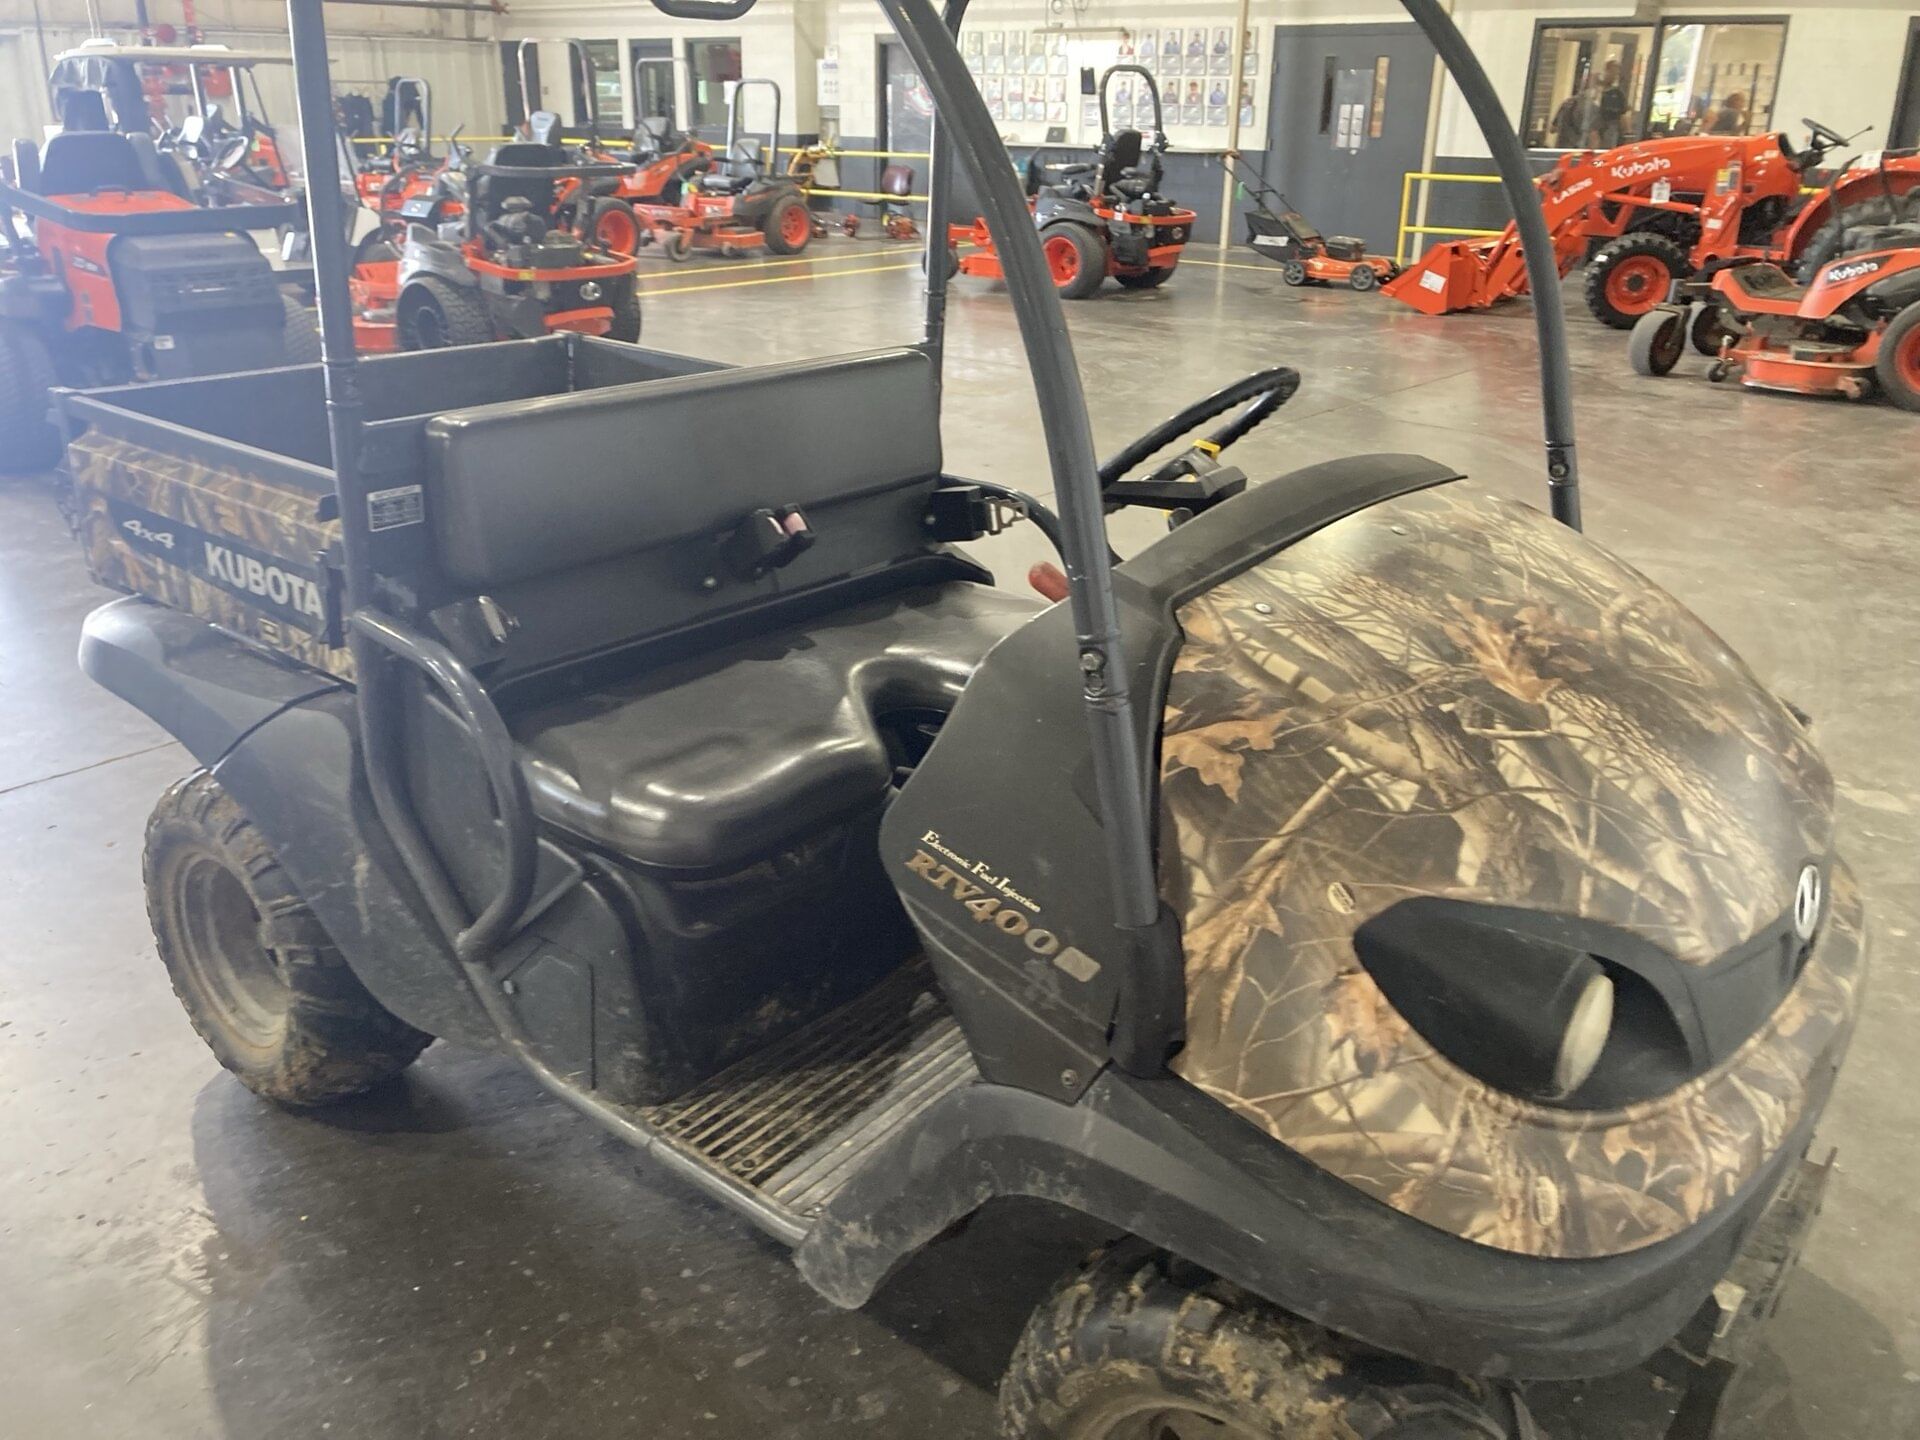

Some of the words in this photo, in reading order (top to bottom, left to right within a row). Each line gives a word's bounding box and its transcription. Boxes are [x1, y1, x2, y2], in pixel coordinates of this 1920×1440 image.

[1611, 157, 1671, 178] Kubota
[1829, 262, 1879, 280] Kubota
[123, 519, 175, 549] 4x4
[204, 541, 324, 620] KUBOTA
[921, 830, 972, 869] Electronic
[971, 862, 998, 885] Fuel
